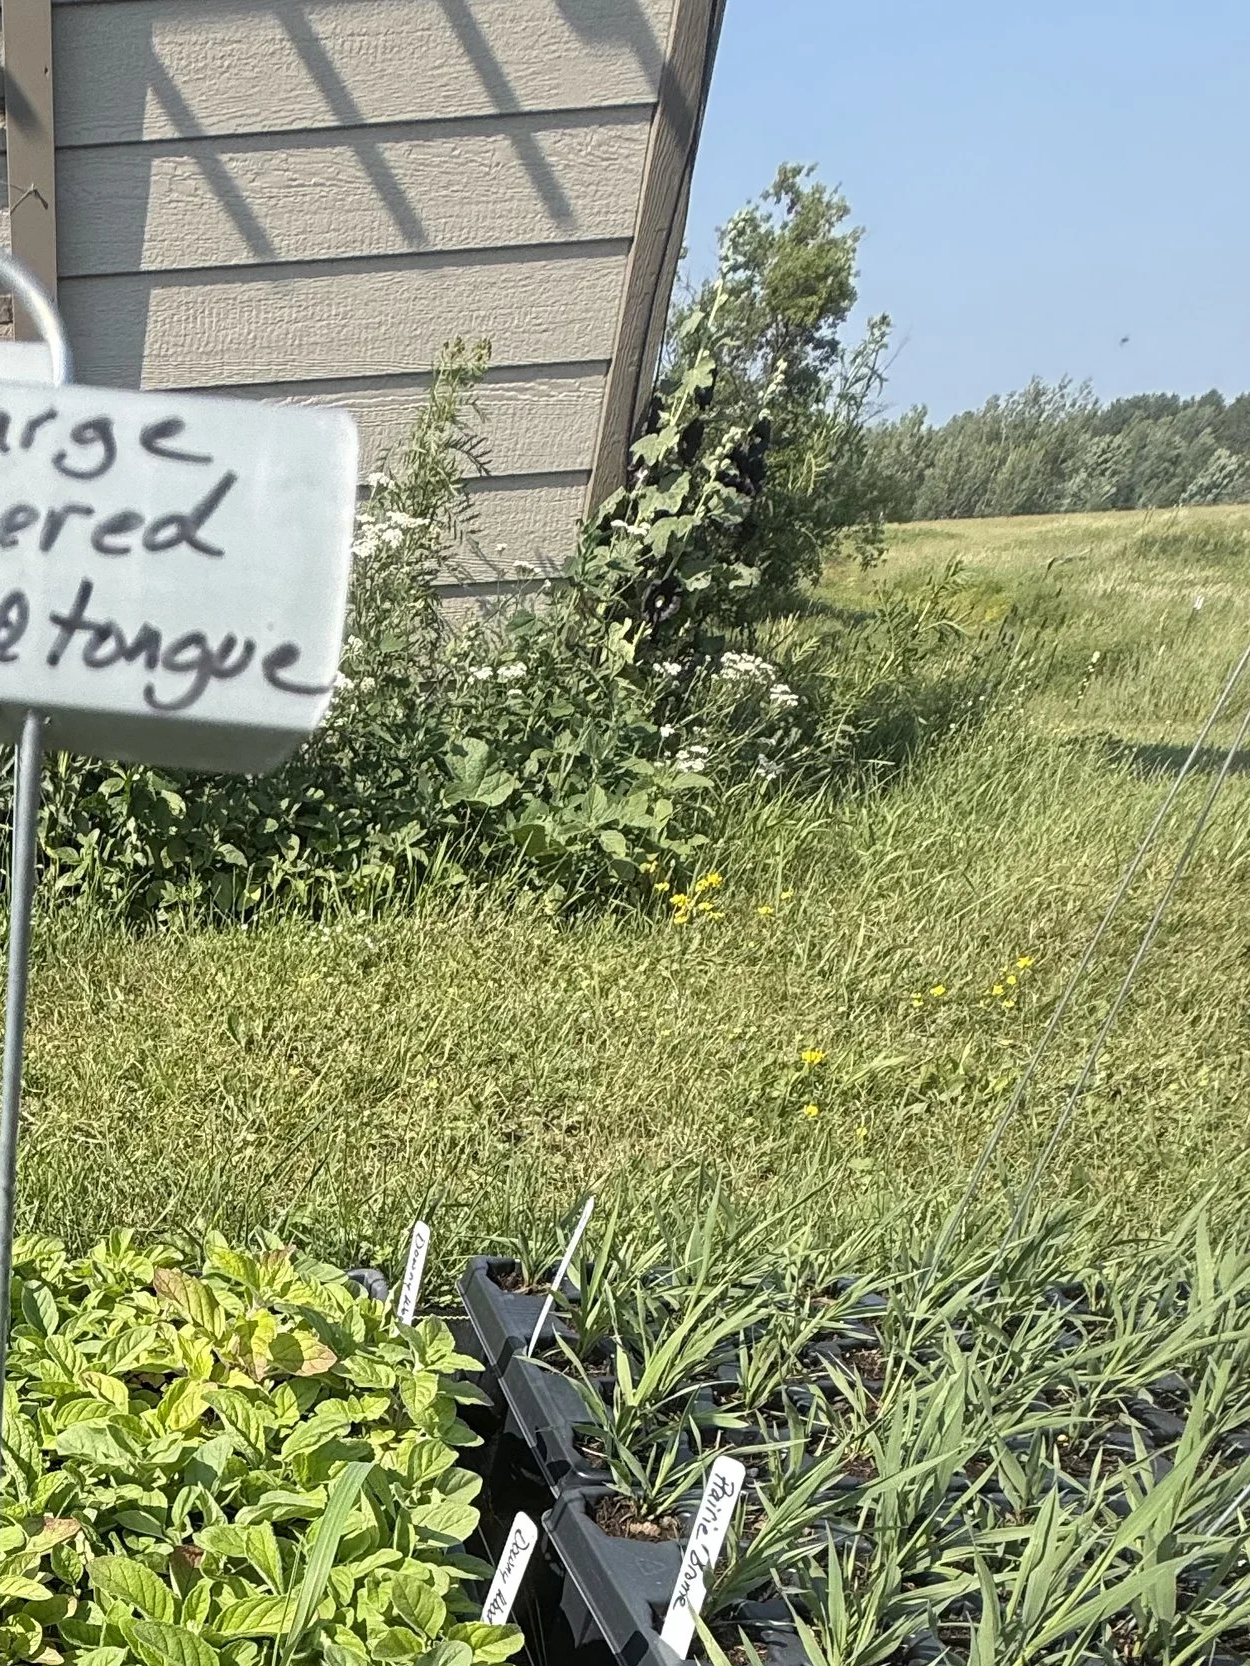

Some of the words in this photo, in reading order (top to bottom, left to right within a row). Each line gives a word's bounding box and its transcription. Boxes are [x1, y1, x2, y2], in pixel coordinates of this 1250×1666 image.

[403, 1232, 427, 1291] Downy
[695, 1473, 735, 1541] Prairie
[498, 1528, 531, 1585] Downy
